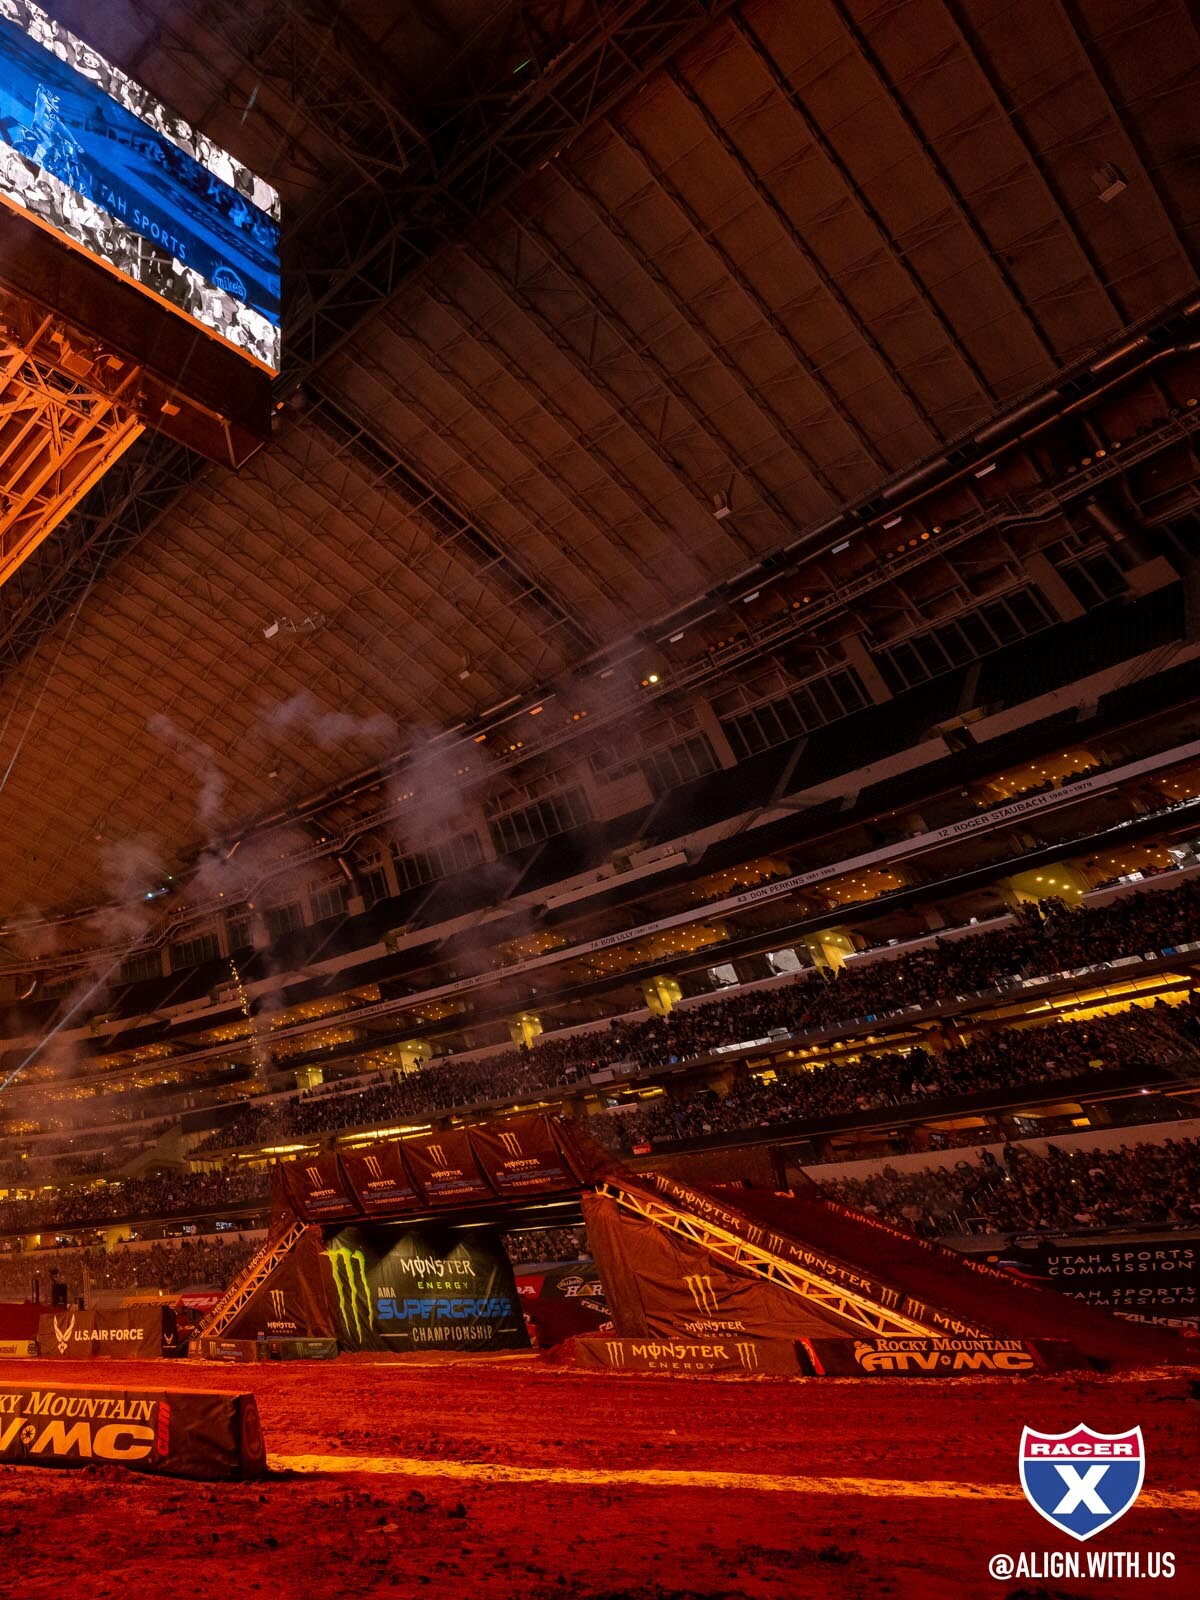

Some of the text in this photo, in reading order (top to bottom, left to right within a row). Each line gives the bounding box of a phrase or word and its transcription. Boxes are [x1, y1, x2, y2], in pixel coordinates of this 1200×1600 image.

[133, 209, 187, 259] SPORTS
[937, 828, 951, 838] 12
[953, 814, 990, 833] ROGER
[990, 796, 1048, 821] STAUBACH
[751, 888, 768, 899] DON
[769, 877, 805, 894] PERKINS
[672, 1186, 742, 1230] MONSTER
[1048, 1249, 1195, 1266] UTAH SPORTS
[400, 1255, 476, 1279] MONSTER
[789, 1245, 873, 1294] MONSTER
[1048, 1259, 1194, 1276] COMMISSION
[378, 1287, 396, 1298] AMA
[418, 1281, 469, 1289] ENERGY
[1112, 1286, 1197, 1298] SPORTS
[377, 1298, 512, 1320] SUPERCROSS
[412, 1325, 493, 1342] CHAMPIONSHIP
[684, 1320, 747, 1332] MONSTER
[74, 1328, 144, 1342] U.S. AIR FORCE
[631, 1342, 730, 1360] MONSTER
[875, 1338, 1023, 1352] ROCKY MOUNTAIN
[649, 1361, 716, 1370] ENERGY
[22, 1390, 157, 1421] MOUNTAIN
